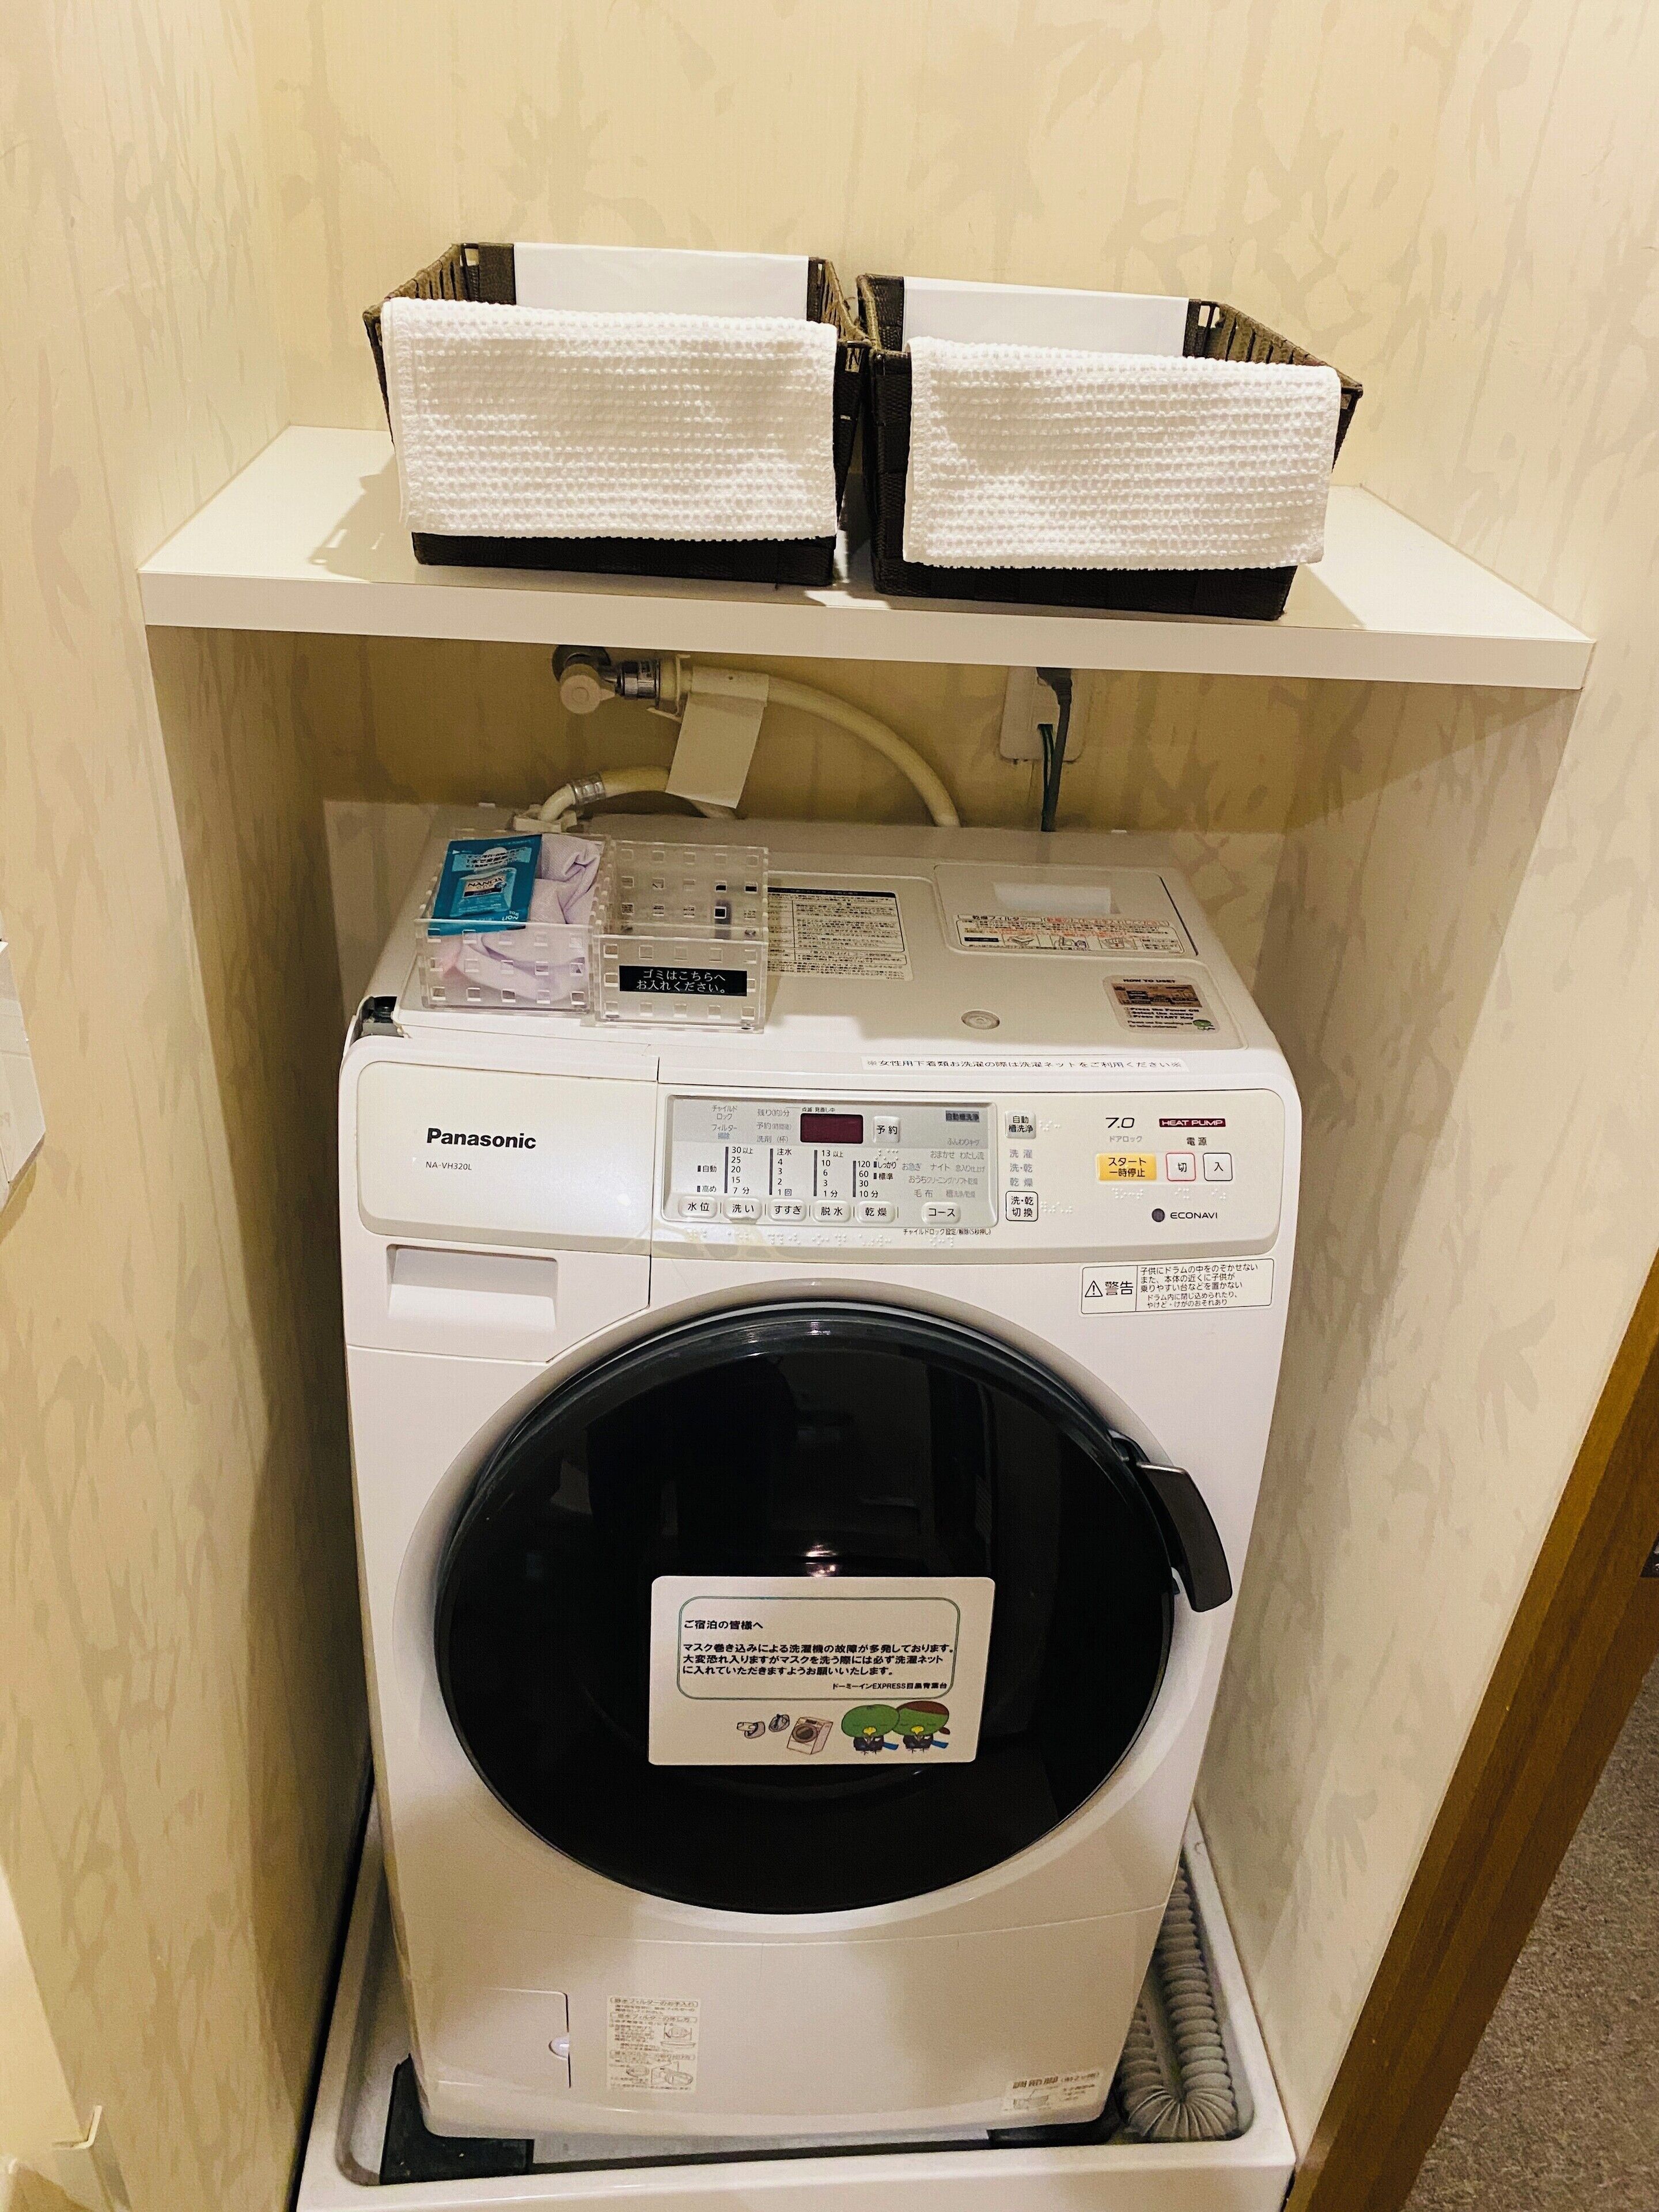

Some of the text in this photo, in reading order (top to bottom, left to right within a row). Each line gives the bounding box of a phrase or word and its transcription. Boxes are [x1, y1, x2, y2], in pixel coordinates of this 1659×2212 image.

[468, 877, 504, 888] NANOX
[643, 969, 726, 982] ゴミはこちらへ
[637, 980, 725, 994] お入れください。
[1105, 1118, 1135, 1128] 7.0
[876, 1126, 897, 1135] 予約
[1009, 1125, 1033, 1133] 槽洗浄
[426, 1127, 537, 1149] Panasonic
[1186, 1137, 1207, 1146] 電源
[1010, 1149, 1032, 1158] 洗濯
[426, 1161, 472, 1171] NA-VH320L
[902, 1162, 922, 1171] お急ぎ
[930, 1163, 950, 1171] ナイト
[1108, 1158, 1146, 1166] スタート
[1177, 1162, 1187, 1172] 切
[1214, 1162, 1224, 1171] 入
[1109, 1168, 1145, 1177] 一時停止
[1010, 1177, 1033, 1187] 乾燥
[914, 1190, 933, 1198] 毛布
[1011, 1196, 1033, 1206] 洗・乾
[732, 1204, 754, 1213] 洗い
[774, 1206, 801, 1214] すすぎ
[821, 1207, 842, 1215] 脱水
[865, 1207, 887, 1217] 乾燥
[929, 1209, 955, 1217] コース
[1012, 1209, 1032, 1217] 切換
[1140, 1264, 1258, 1275] 子供にドラムの中をのぞかせない
[1141, 1272, 1235, 1284] また、本体の近くに子供が
[1105, 1281, 1134, 1296] 警告
[1141, 1281, 1243, 1293] 乗りやすい台などを置かない
[1147, 1291, 1238, 1301] ドラム内に閉じ込められたり、
[1147, 1299, 1228, 1309] やけど・けがのおそれあり
[684, 1619, 763, 1630] ご宿泊の皆様へ
[683, 1643, 955, 1654] マスク巻き込みによる洗濯機の故障が多発しております。
[683, 1654, 944, 1665] 大変恐れ入りますがマスクを洗う際には必ず洗濯ネット
[683, 1665, 893, 1676] に入れていただきますようお願いいたします。
